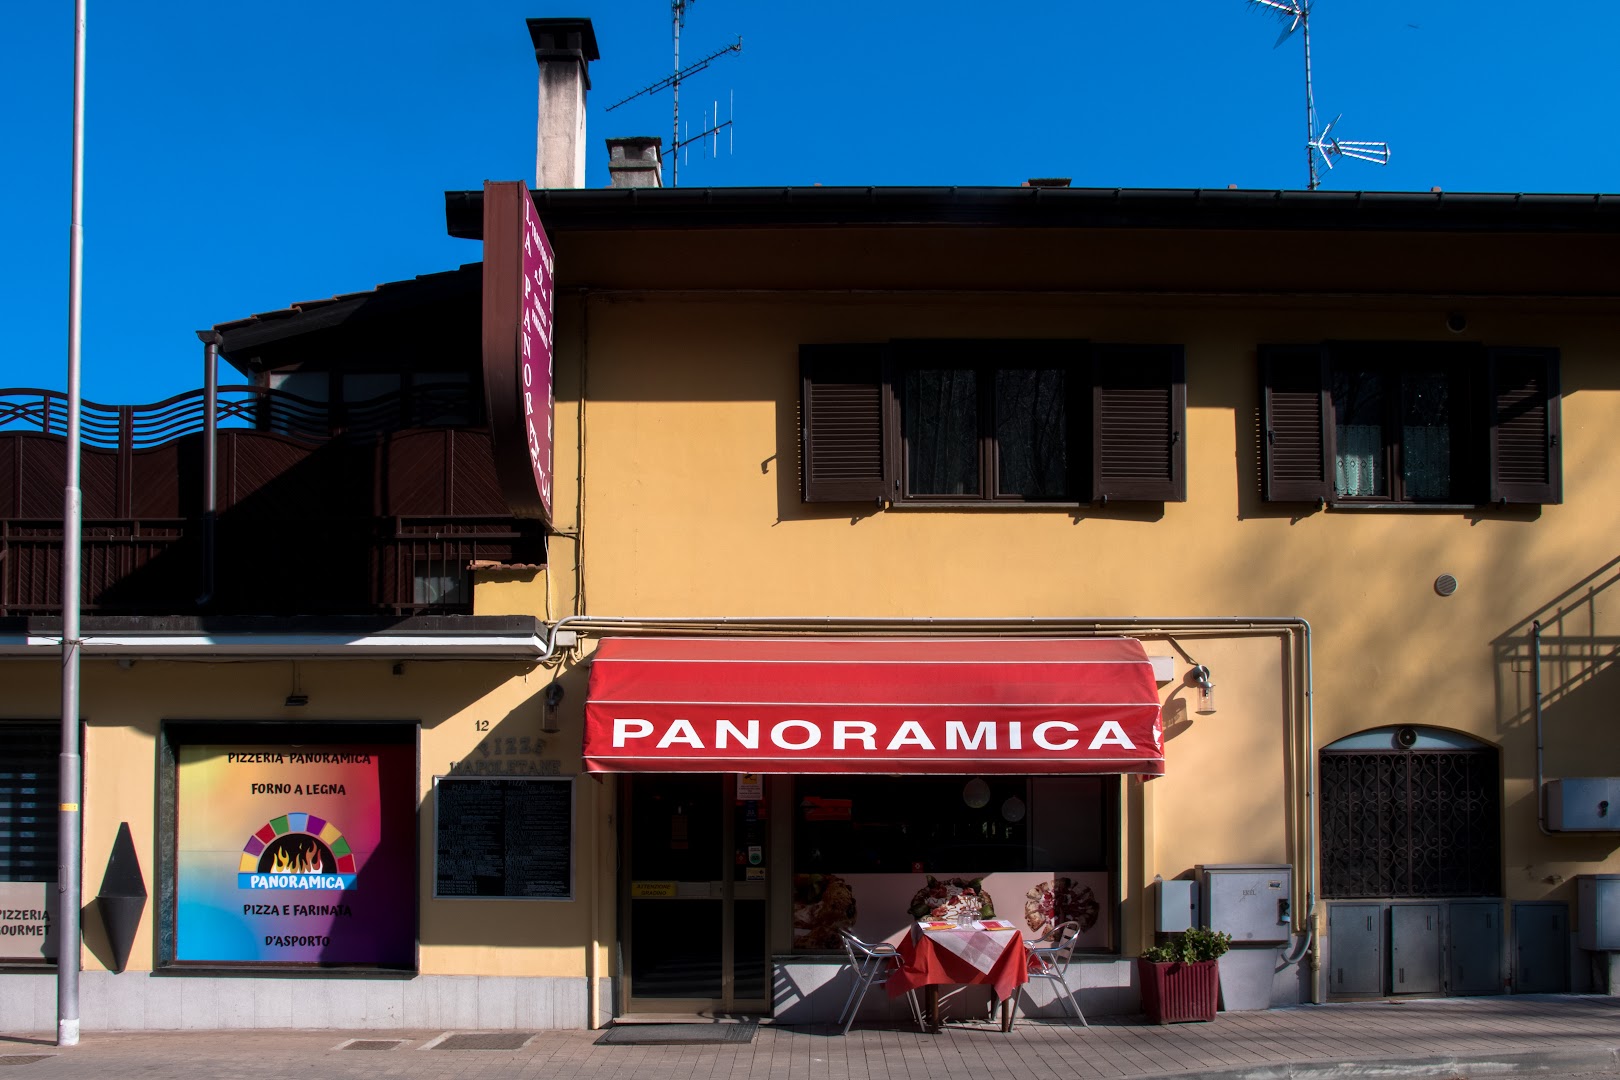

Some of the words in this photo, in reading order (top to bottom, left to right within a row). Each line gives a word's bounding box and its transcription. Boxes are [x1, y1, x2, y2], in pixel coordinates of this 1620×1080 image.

[524, 199, 532, 258] LA
[474, 720, 490, 732] 12
[612, 718, 1137, 751] PANORAMICA
[228, 752, 284, 764] PIZZERIA
[289, 752, 371, 765] PANORAMICA
[251, 783, 291, 796] FORNO
[294, 784, 303, 795] A
[306, 783, 346, 796] LEGNA
[250, 875, 345, 890] PANORAMICA
[243, 904, 280, 916] PIZZA
[283, 905, 290, 916] E
[293, 904, 352, 917] FARINATA
[0, 924, 51, 936] OURMET
[265, 935, 330, 947] D'ASPORTO
